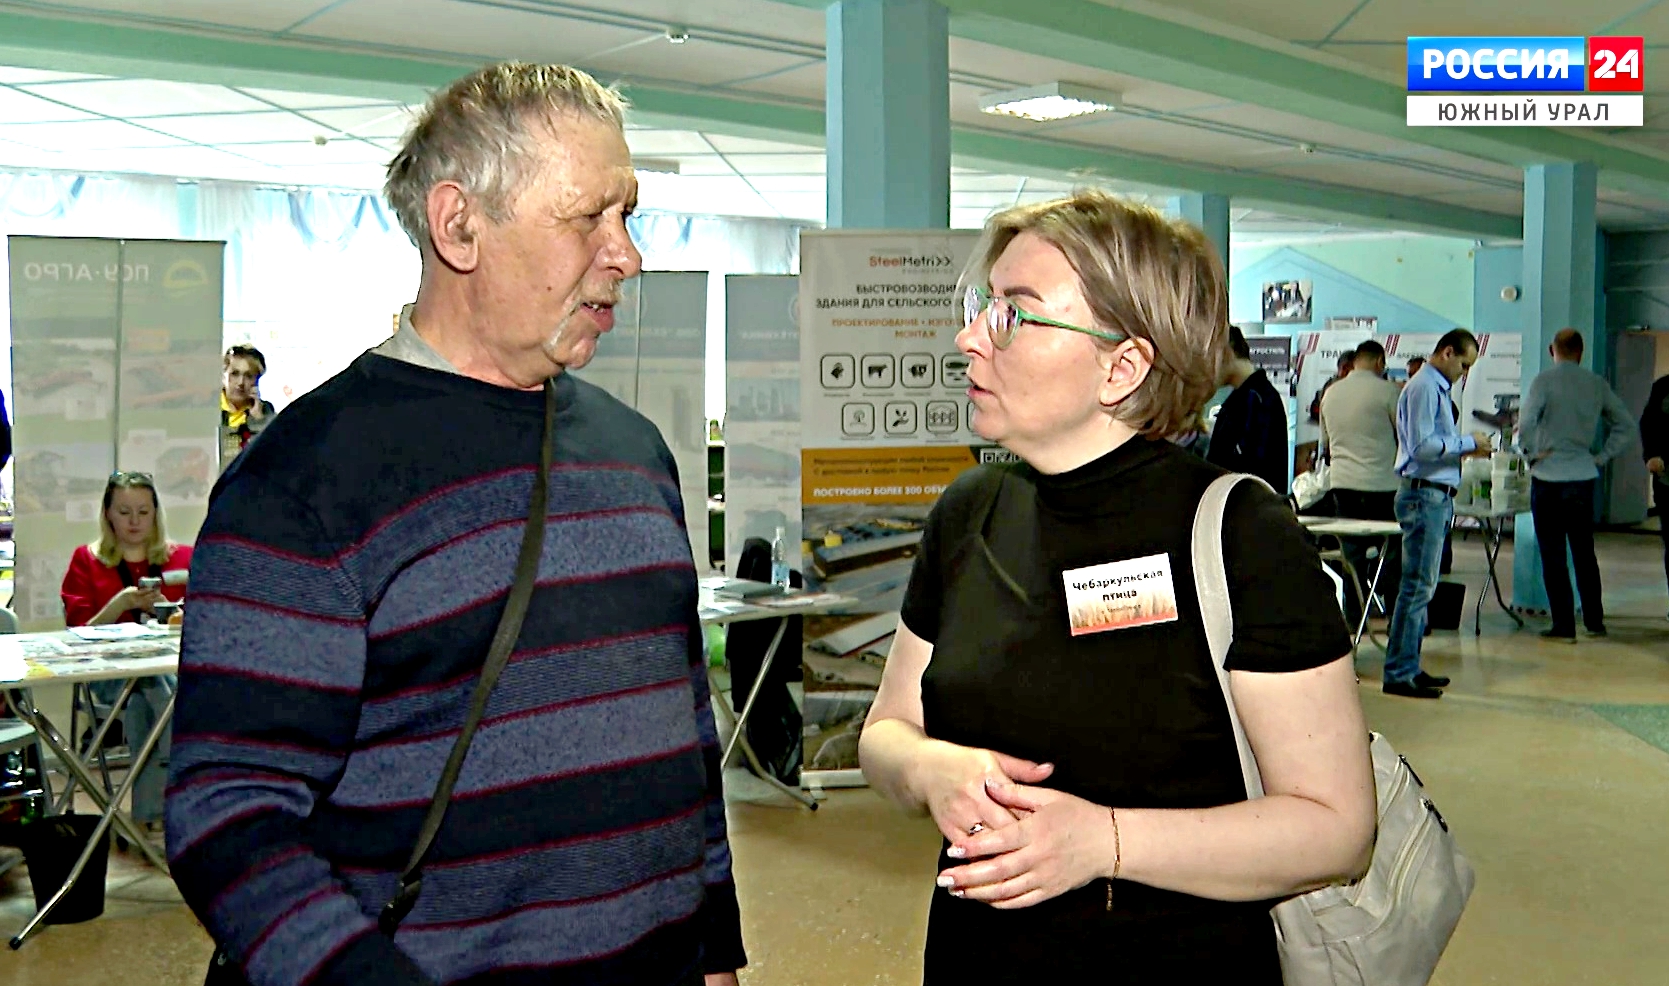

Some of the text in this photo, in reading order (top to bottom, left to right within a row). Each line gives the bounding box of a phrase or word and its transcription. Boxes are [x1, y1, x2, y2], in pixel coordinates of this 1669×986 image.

[816, 297, 952, 309] ЗДАНИЯ ДЛЯ СЕЛЬСКОГО
[831, 318, 919, 327] ПРОЕКТИРОВАНИЕ
[894, 329, 937, 338] МОНТАЖ
[813, 487, 872, 497] ПОСТРОЕНО
[873, 486, 903, 496] БОЛЕЕ
[1072, 570, 1163, 590] Чебаркульская
[1102, 589, 1138, 602] птица
